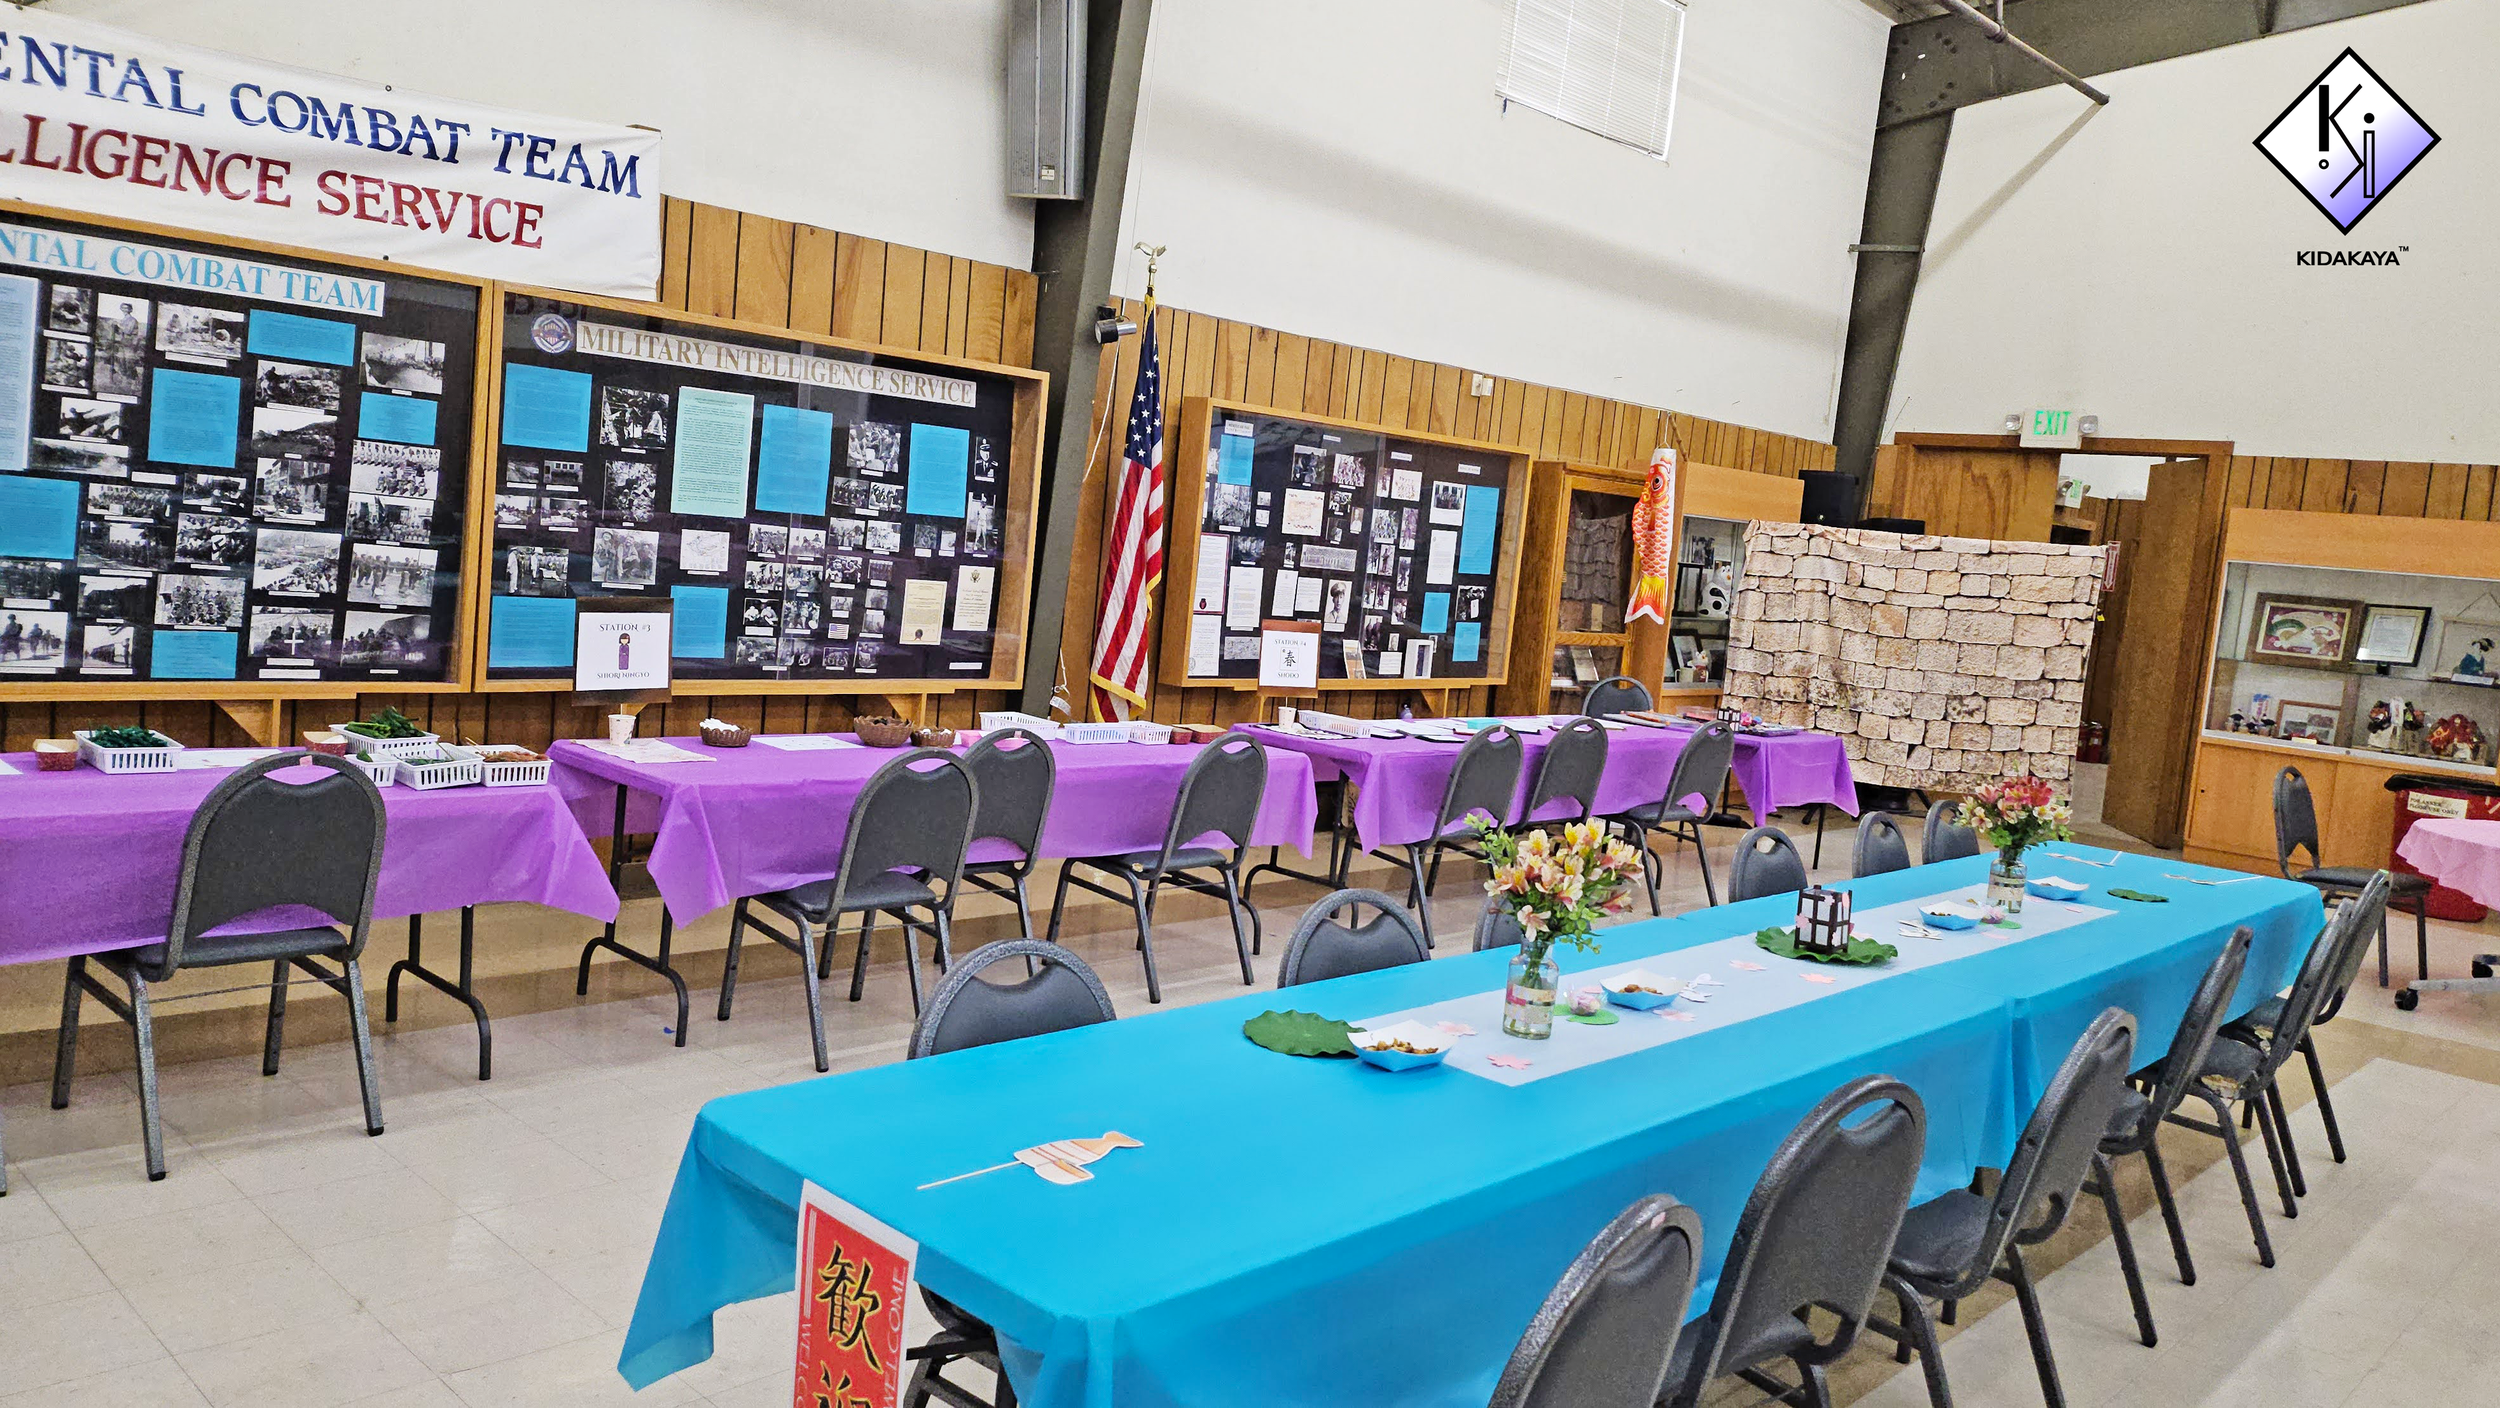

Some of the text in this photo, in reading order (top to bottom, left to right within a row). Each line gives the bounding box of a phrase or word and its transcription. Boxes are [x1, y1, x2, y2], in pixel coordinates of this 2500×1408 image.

[0, 31, 642, 199] NTAL COMBAT TEAM
[317, 170, 543, 249] SERVICE
[110, 245, 270, 295] COMBAT
[279, 271, 378, 311] TEAM
[582, 325, 972, 403] MILITARY INTELLIGENCE SERVICE
[2033, 410, 2072, 435] EXIT
[599, 623, 639, 632] STATION
